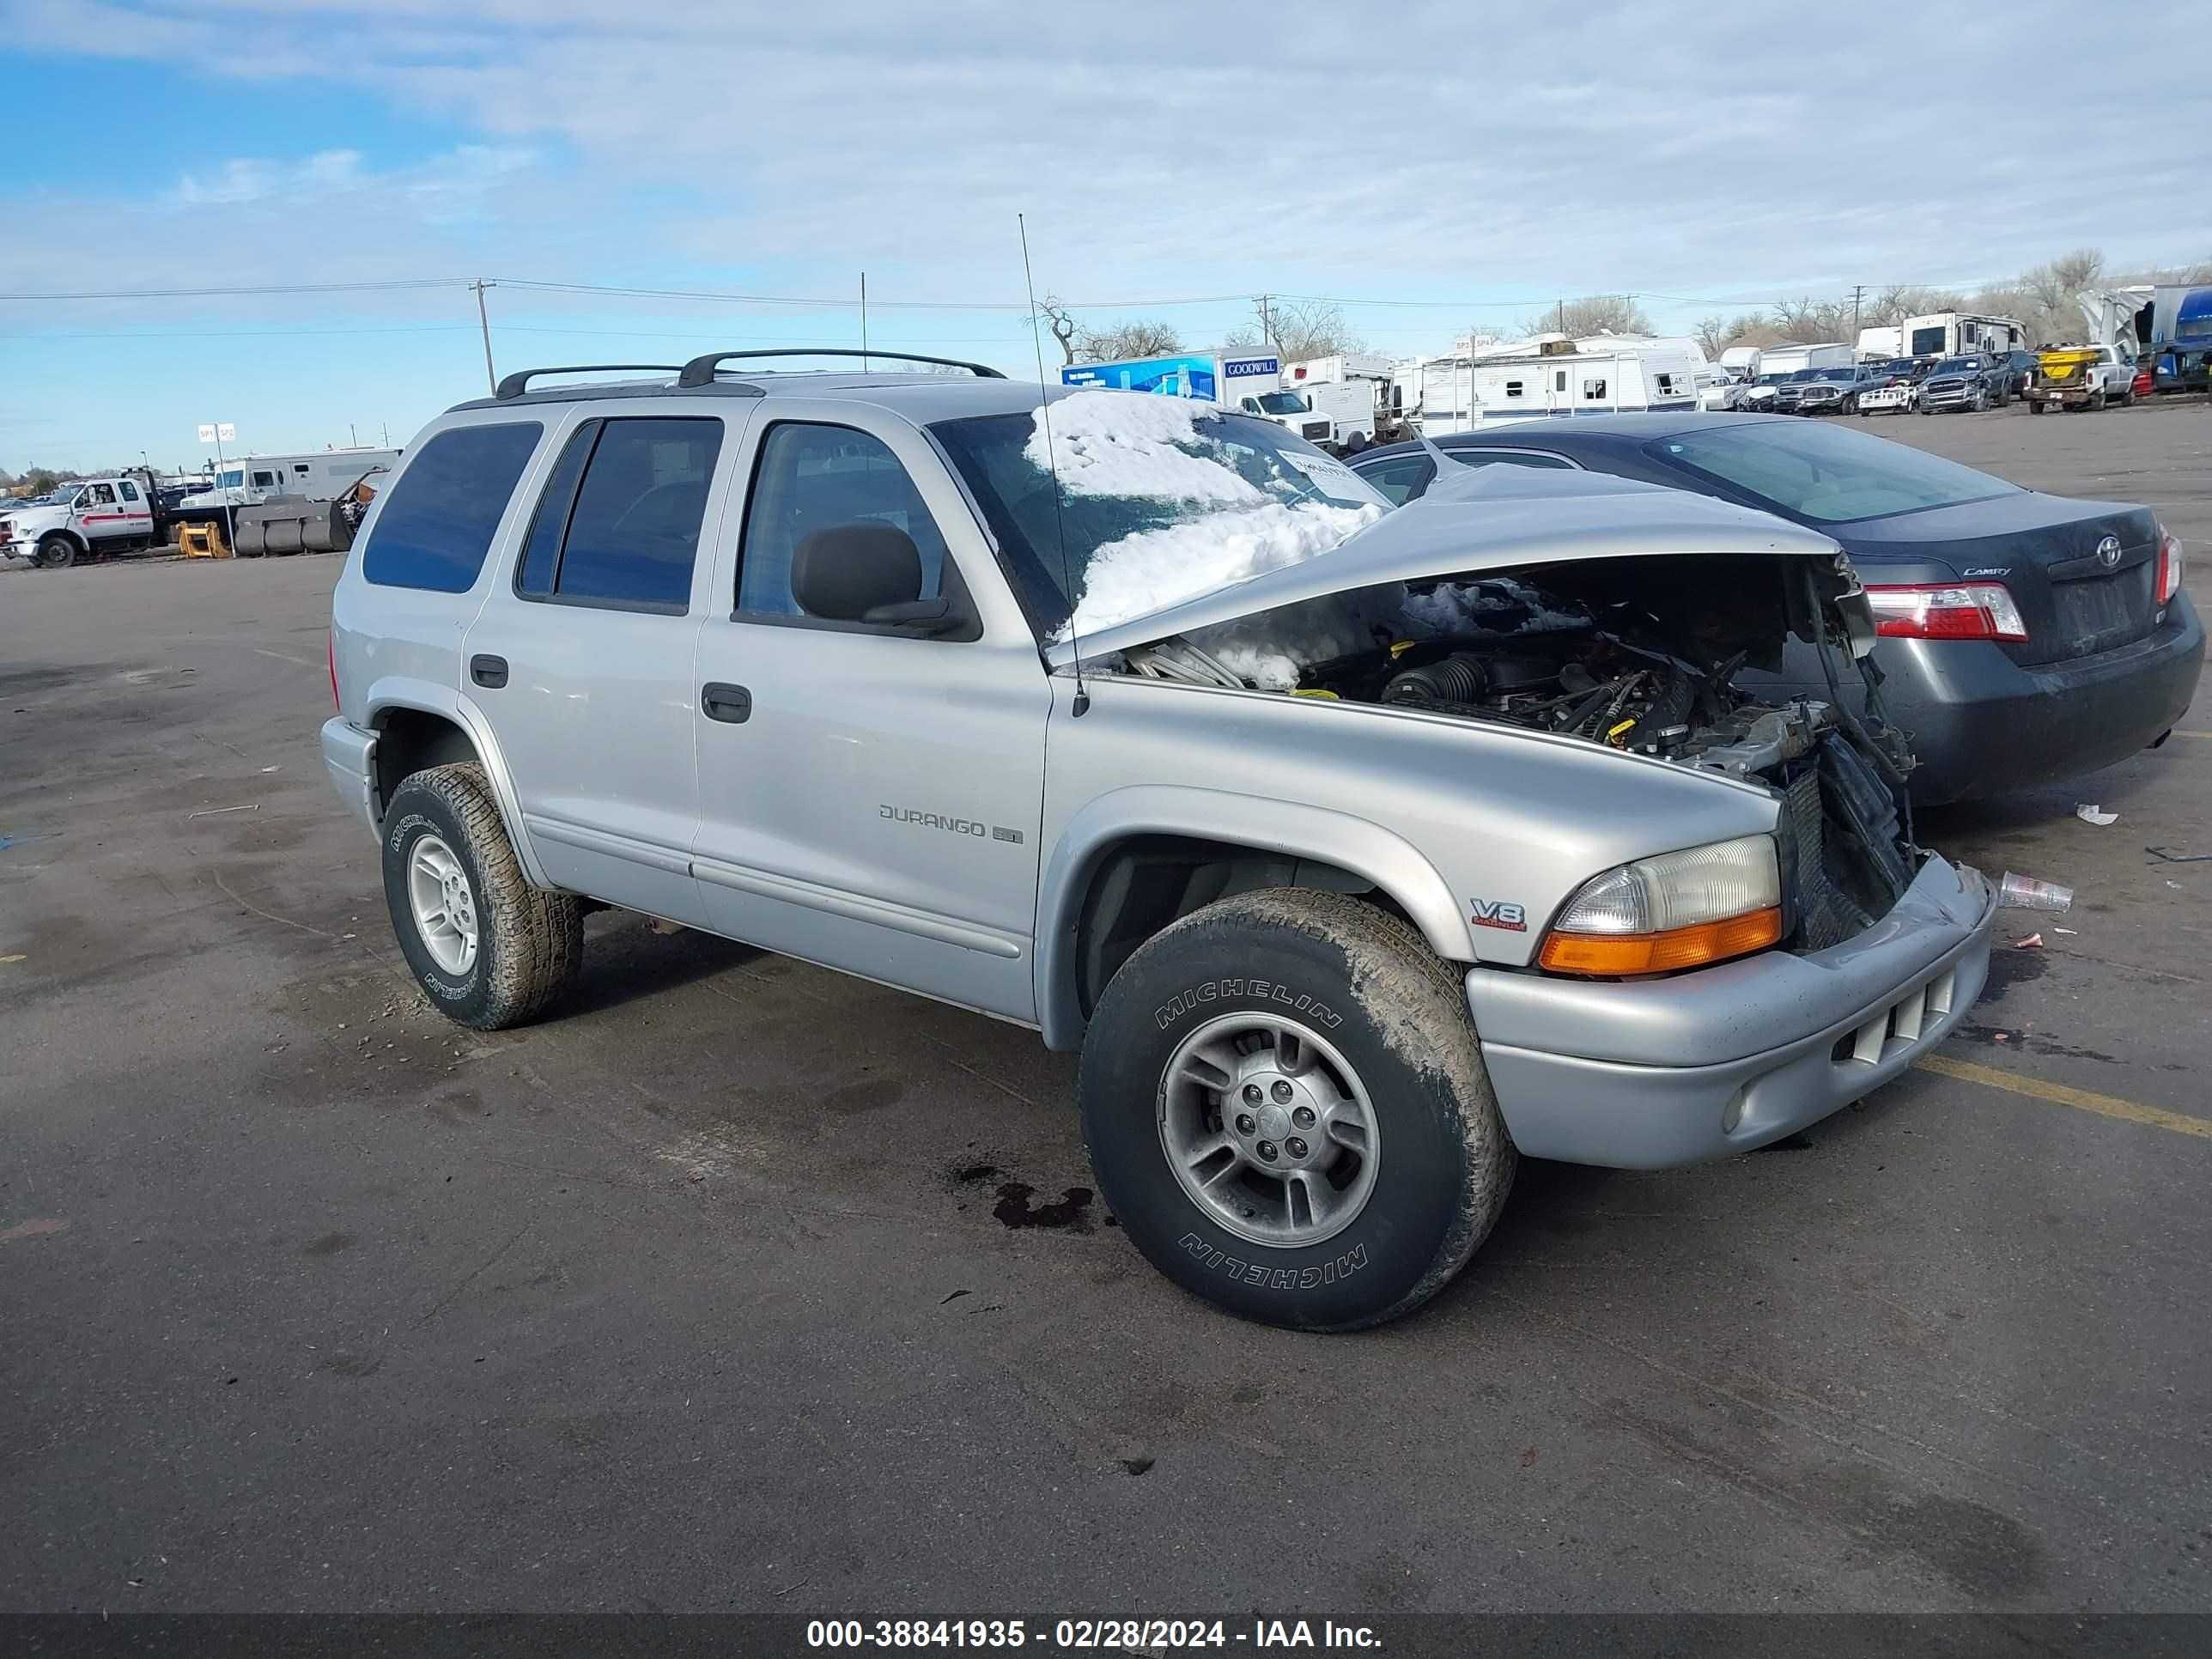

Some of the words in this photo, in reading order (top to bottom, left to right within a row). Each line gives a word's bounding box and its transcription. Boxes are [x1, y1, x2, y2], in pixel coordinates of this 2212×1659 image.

[1228, 362, 1276, 375] GOODWILL
[1964, 568, 2013, 576] CAMRY
[391, 814, 443, 852] MICHELIN
[879, 804, 986, 838] DURANGO
[1470, 898, 1526, 924] V8
[1472, 915, 1527, 932] MAGNUM
[1154, 979, 1344, 1030] MICHELIN
[1177, 1232, 1369, 1290] MICHELIN
